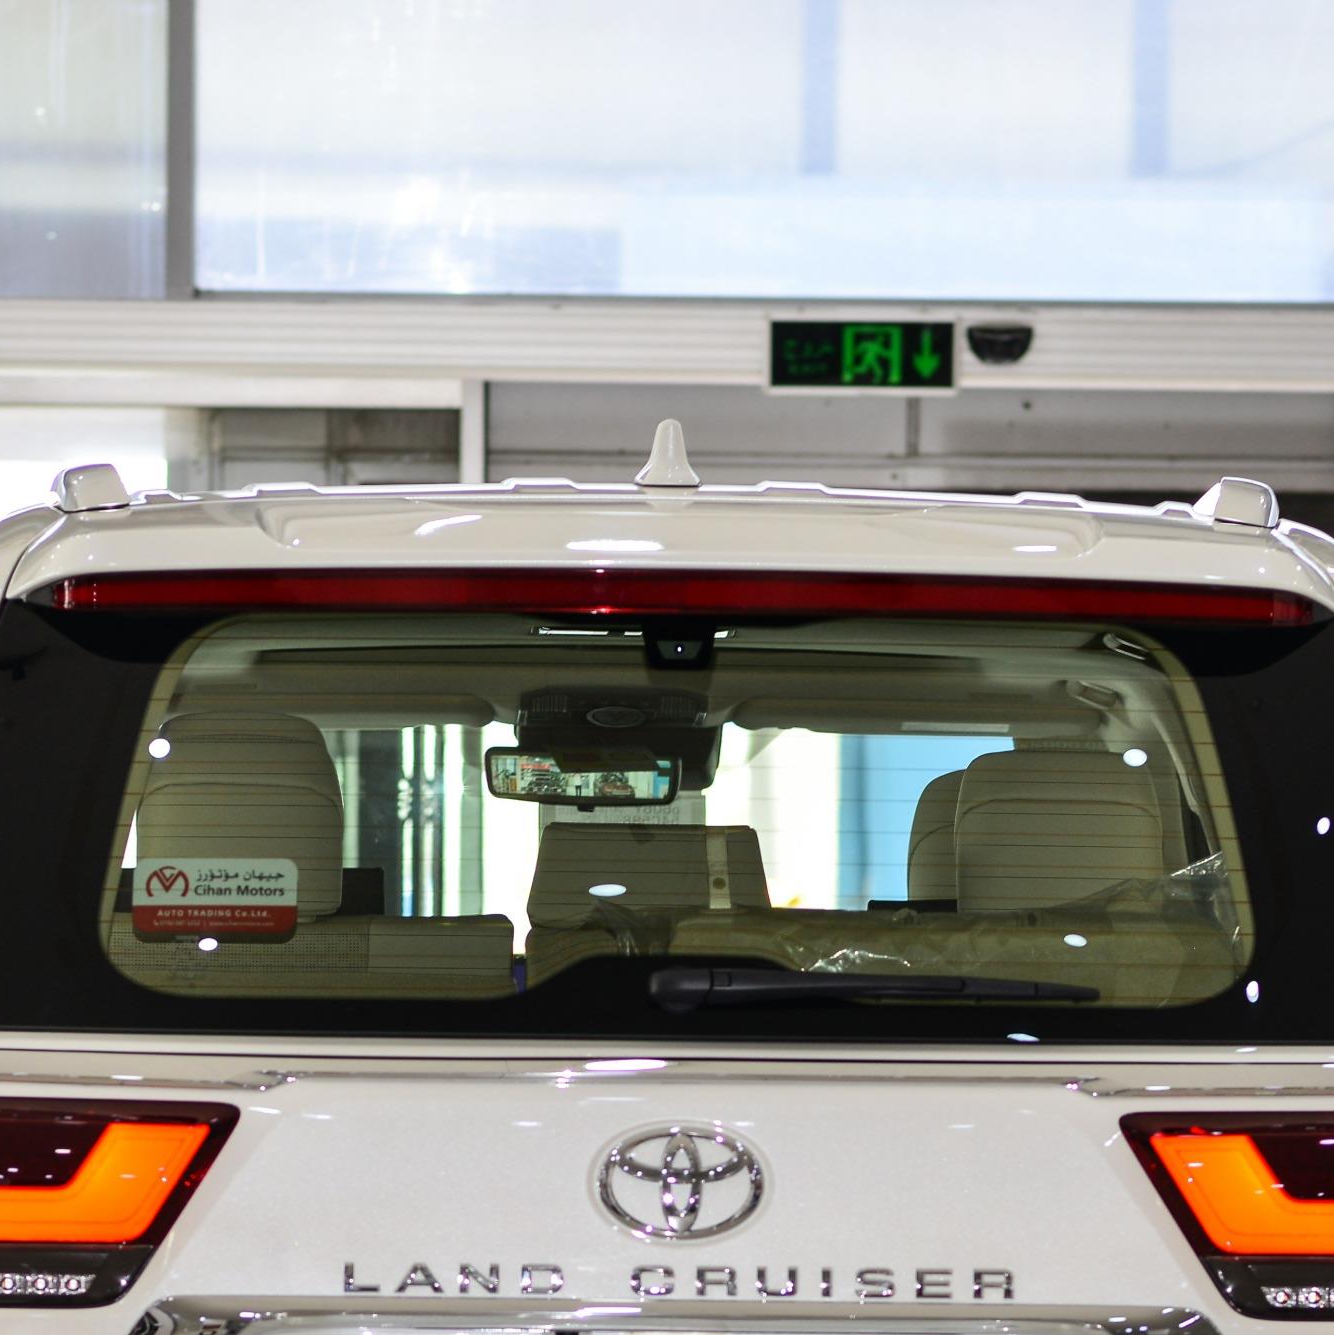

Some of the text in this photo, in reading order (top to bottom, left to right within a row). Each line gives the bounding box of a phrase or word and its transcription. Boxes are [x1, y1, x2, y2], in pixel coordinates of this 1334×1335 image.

[194, 884, 285, 897] Cihan Motors
[156, 909, 184, 918] AUTO
[187, 909, 232, 918] TRADING
[343, 1261, 1016, 1301] LAND CRUISER
